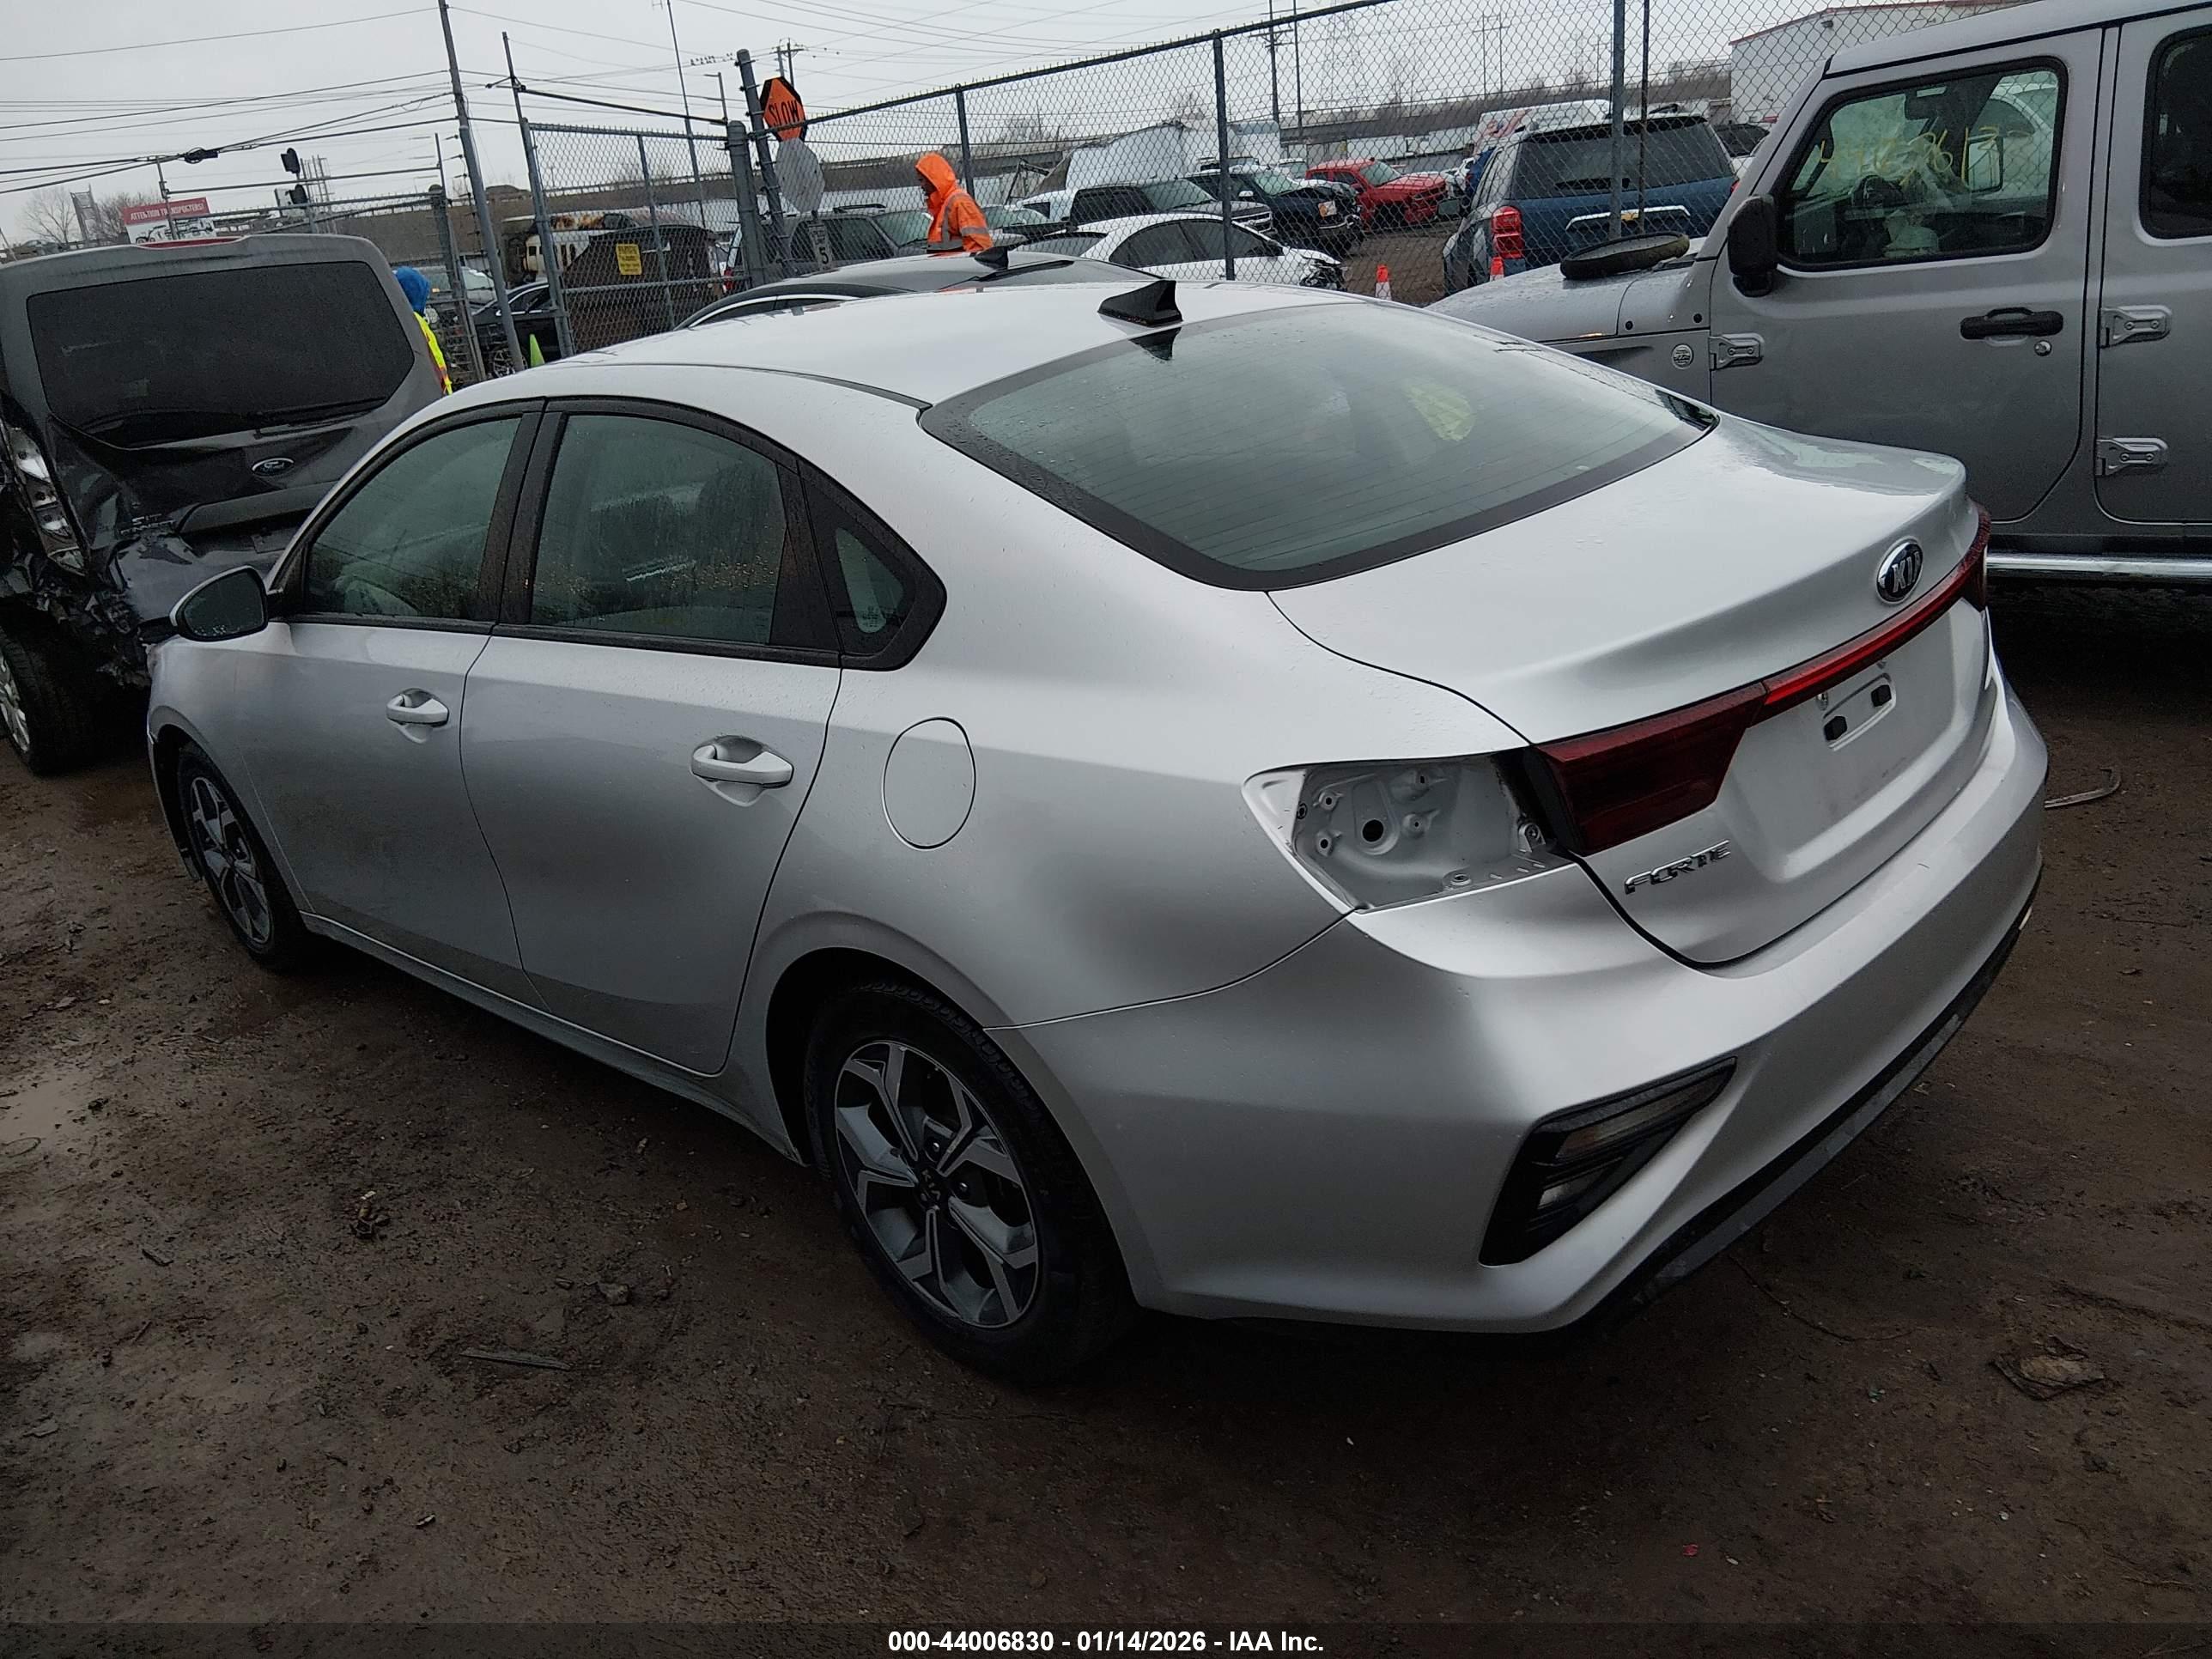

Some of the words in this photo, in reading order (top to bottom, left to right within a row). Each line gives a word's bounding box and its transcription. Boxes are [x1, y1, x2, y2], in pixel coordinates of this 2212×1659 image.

[768, 100, 800, 127] SLOW
[131, 209, 160, 221] ATTENTION
[818, 246, 830, 264] 5
[1891, 550, 1922, 593] KIA
[1624, 839, 1730, 896] FORTE
